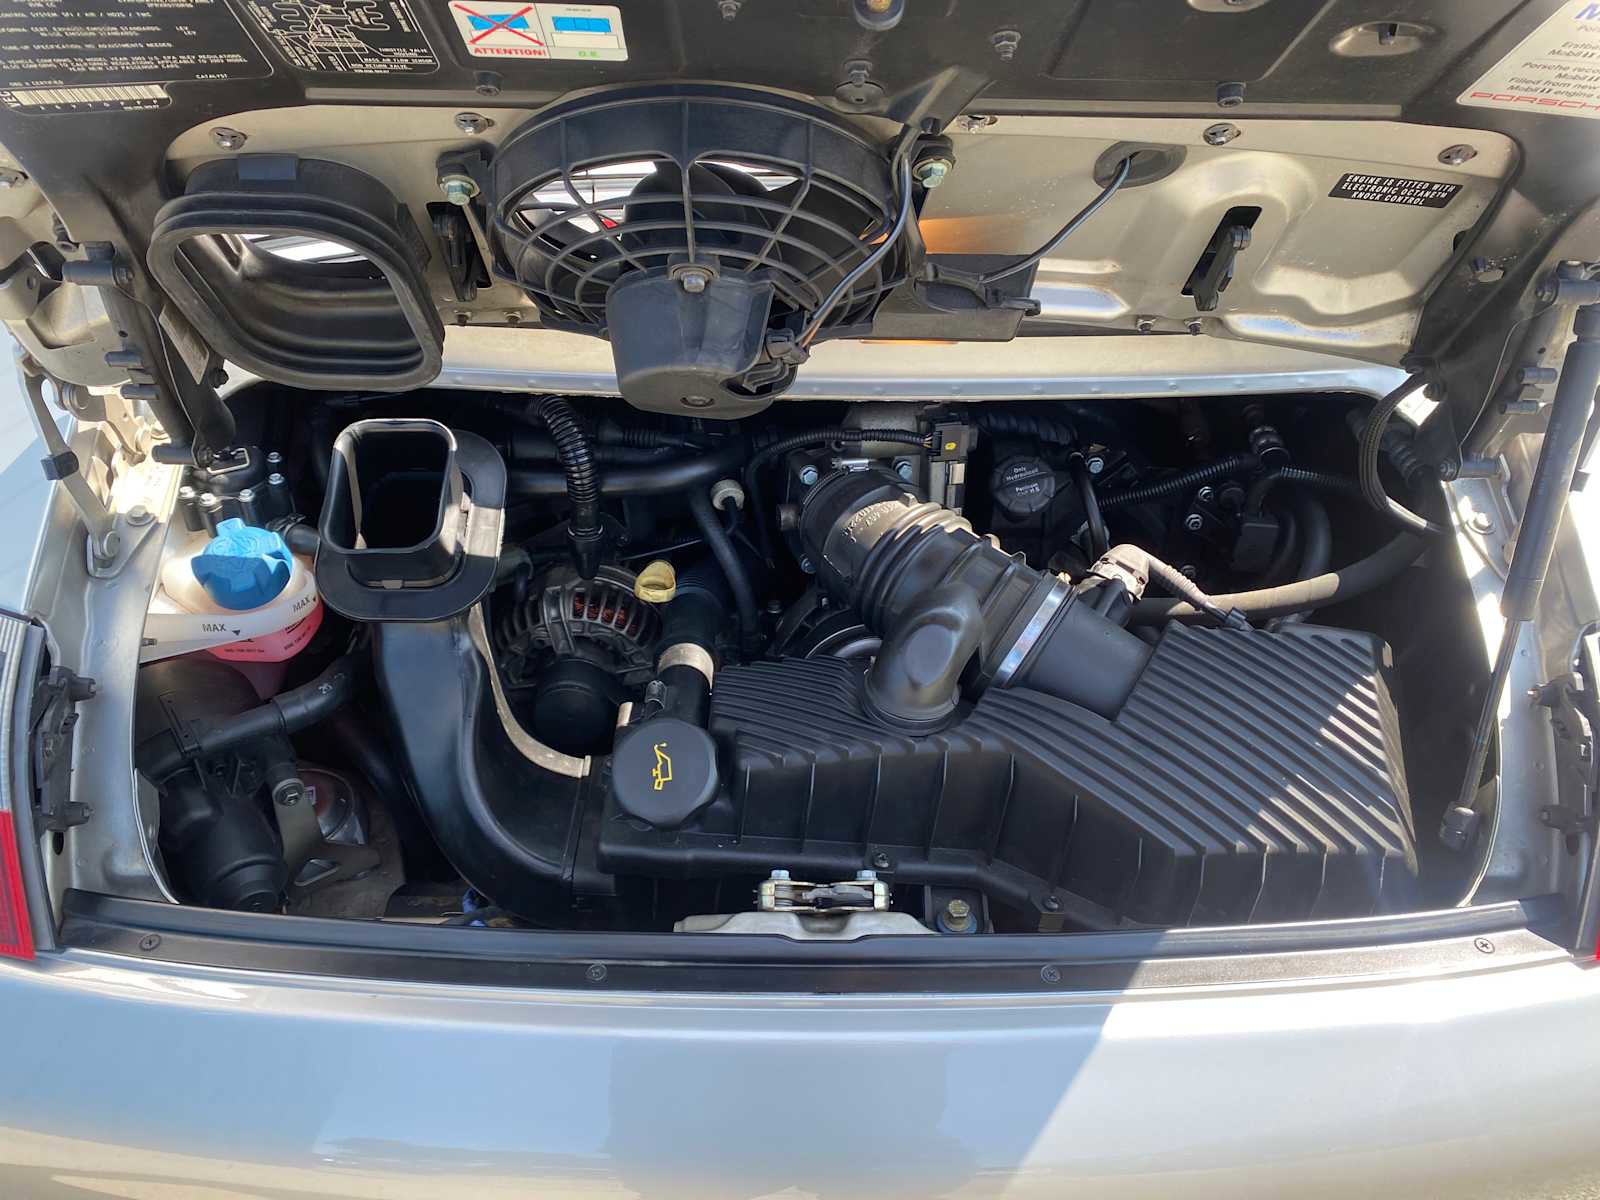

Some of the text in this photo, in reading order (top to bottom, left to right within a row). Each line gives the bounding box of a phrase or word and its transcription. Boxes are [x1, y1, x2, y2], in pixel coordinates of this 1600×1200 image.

[474, 47, 546, 56] ATTENTION!
[1522, 62, 1570, 71] Porsche
[1508, 77, 1541, 86] Filled
[1543, 80, 1571, 88] from
[1553, 90, 1594, 98] engine
[1341, 182, 1399, 195] ELECTRONIC
[1346, 175, 1456, 193] ENGINE IS FITTED WITH
[1351, 191, 1426, 206] KNOCK CONTROL
[292, 597, 311, 613] MAX
[202, 623, 228, 633] MAX
